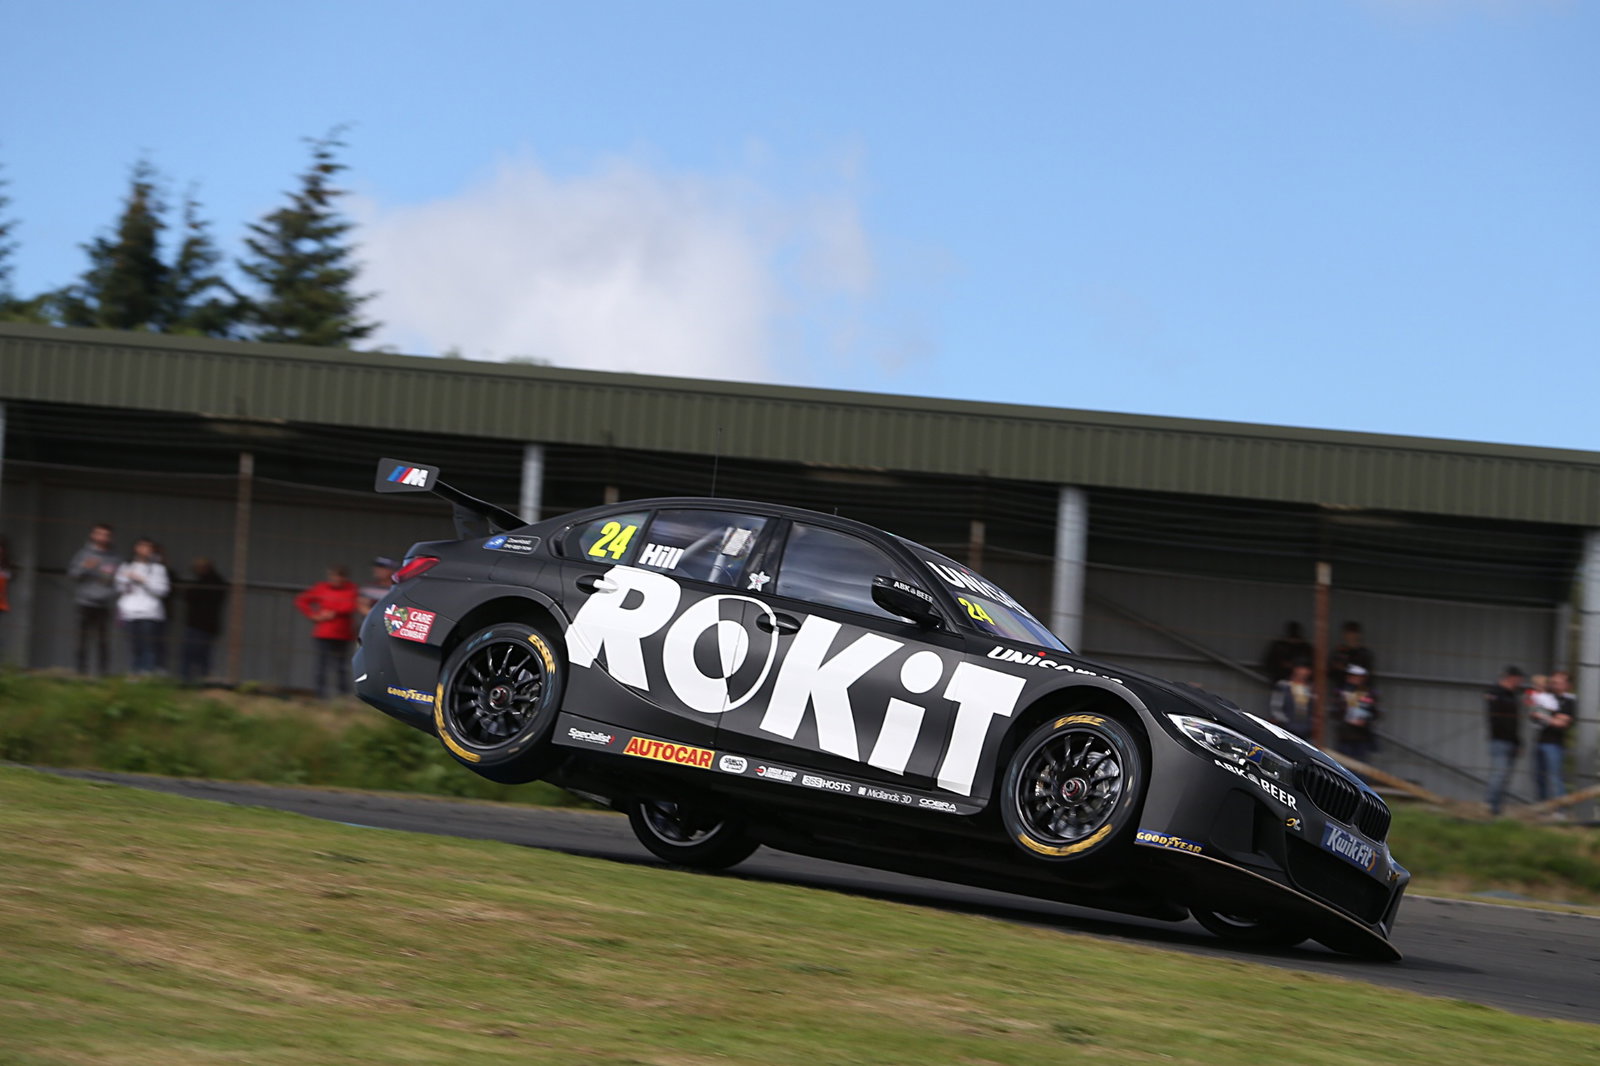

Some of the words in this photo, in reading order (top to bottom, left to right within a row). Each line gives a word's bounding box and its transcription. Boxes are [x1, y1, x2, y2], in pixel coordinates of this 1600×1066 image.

[588, 521, 638, 560] 24
[638, 543, 685, 570] Hill
[409, 611, 433, 625] CARE
[957, 597, 996, 626] 24
[406, 621, 430, 633] AFTER
[625, 738, 713, 767] AUTOCAR
[867, 788, 900, 802] Midlands
[919, 798, 957, 810] COBRA
[1260, 779, 1298, 811] BEER
[1137, 831, 1202, 853] GOODYEAR
